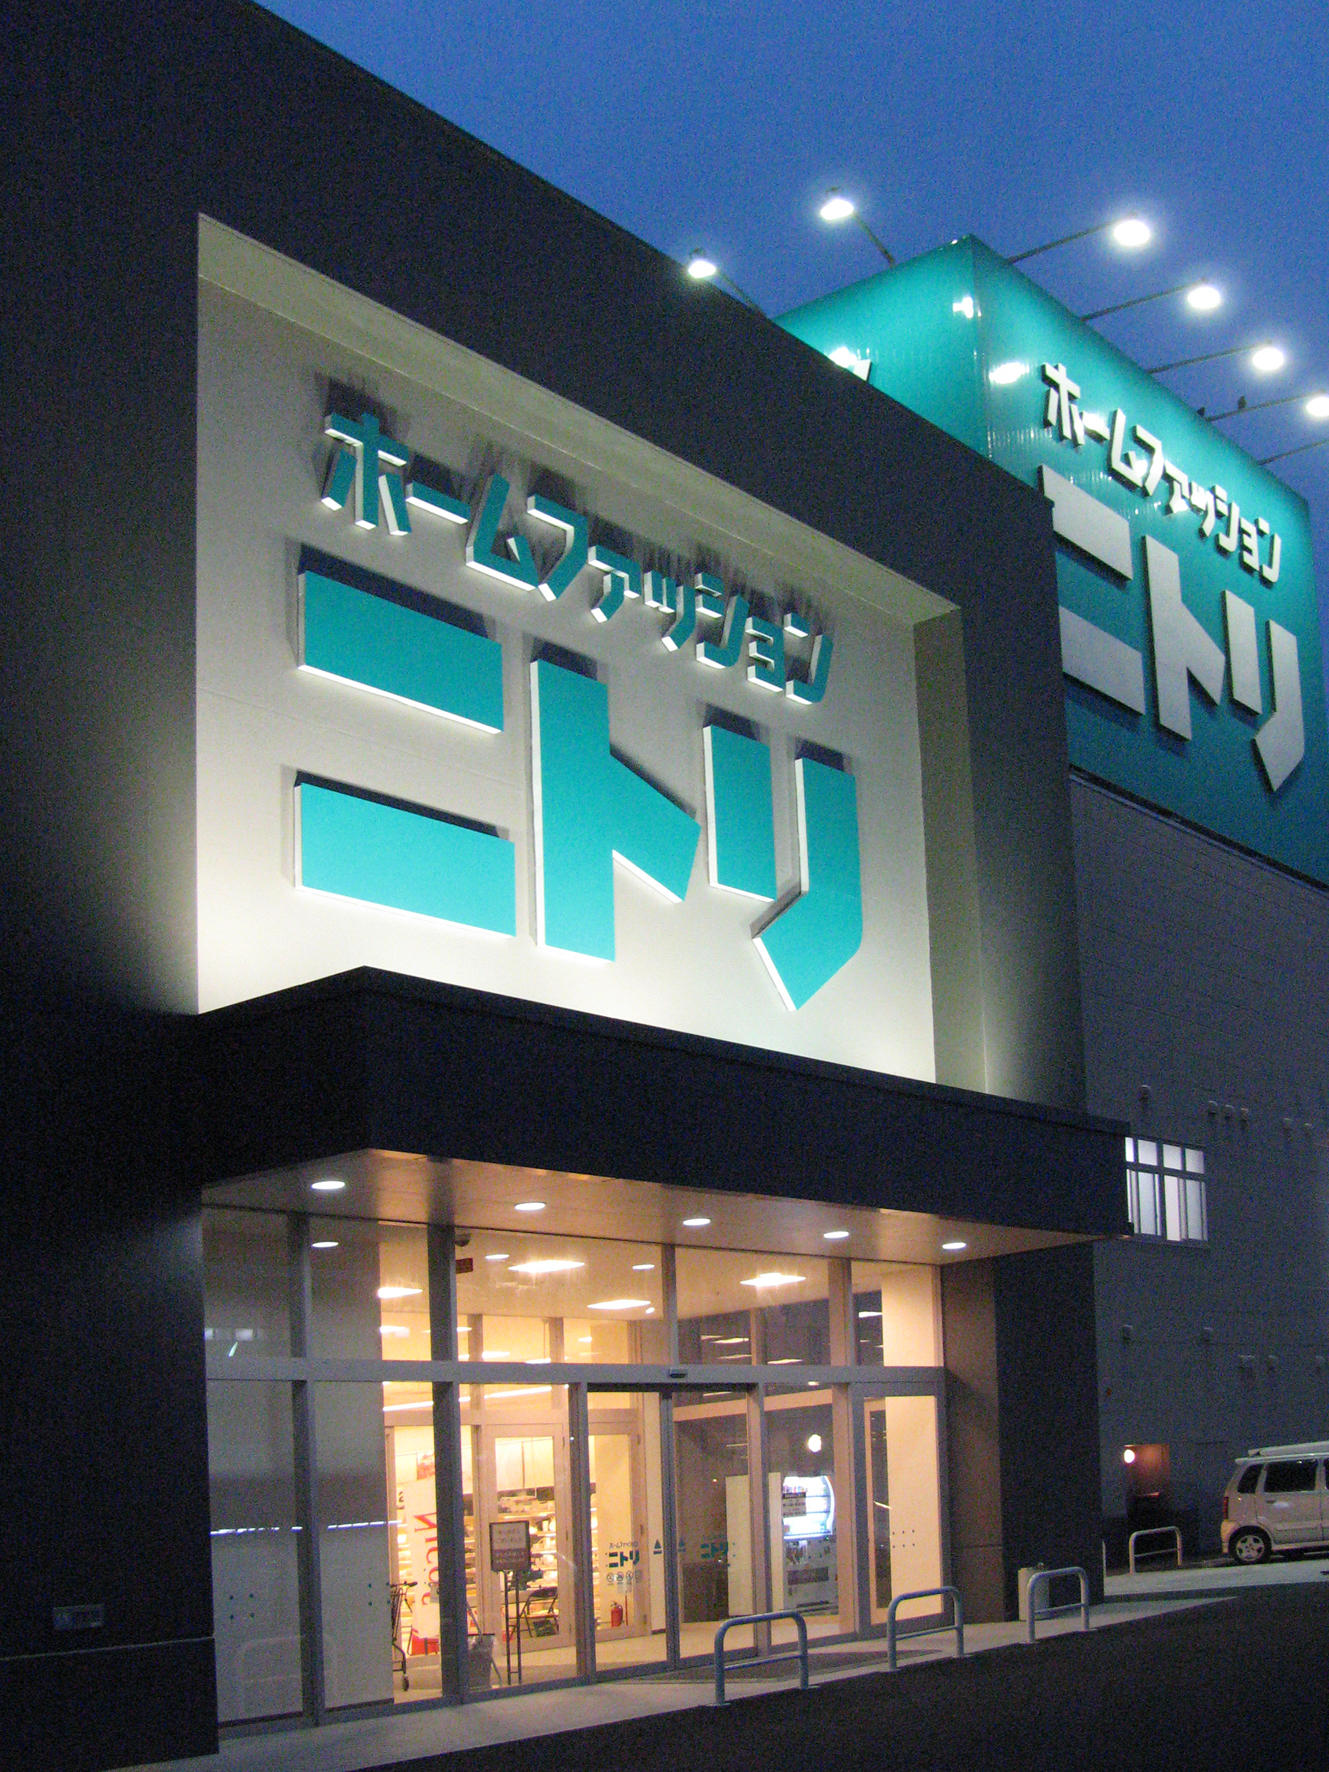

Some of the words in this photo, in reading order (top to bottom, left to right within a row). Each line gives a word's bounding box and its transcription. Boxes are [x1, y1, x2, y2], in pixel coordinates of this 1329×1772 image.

[321, 412, 834, 705] ホームファッション
[1041, 362, 1282, 584] ホームファッション
[1038, 463, 1305, 793] ニトリ
[295, 570, 863, 1011] ニトリ
[608, 1550, 639, 1568] ニトリ
